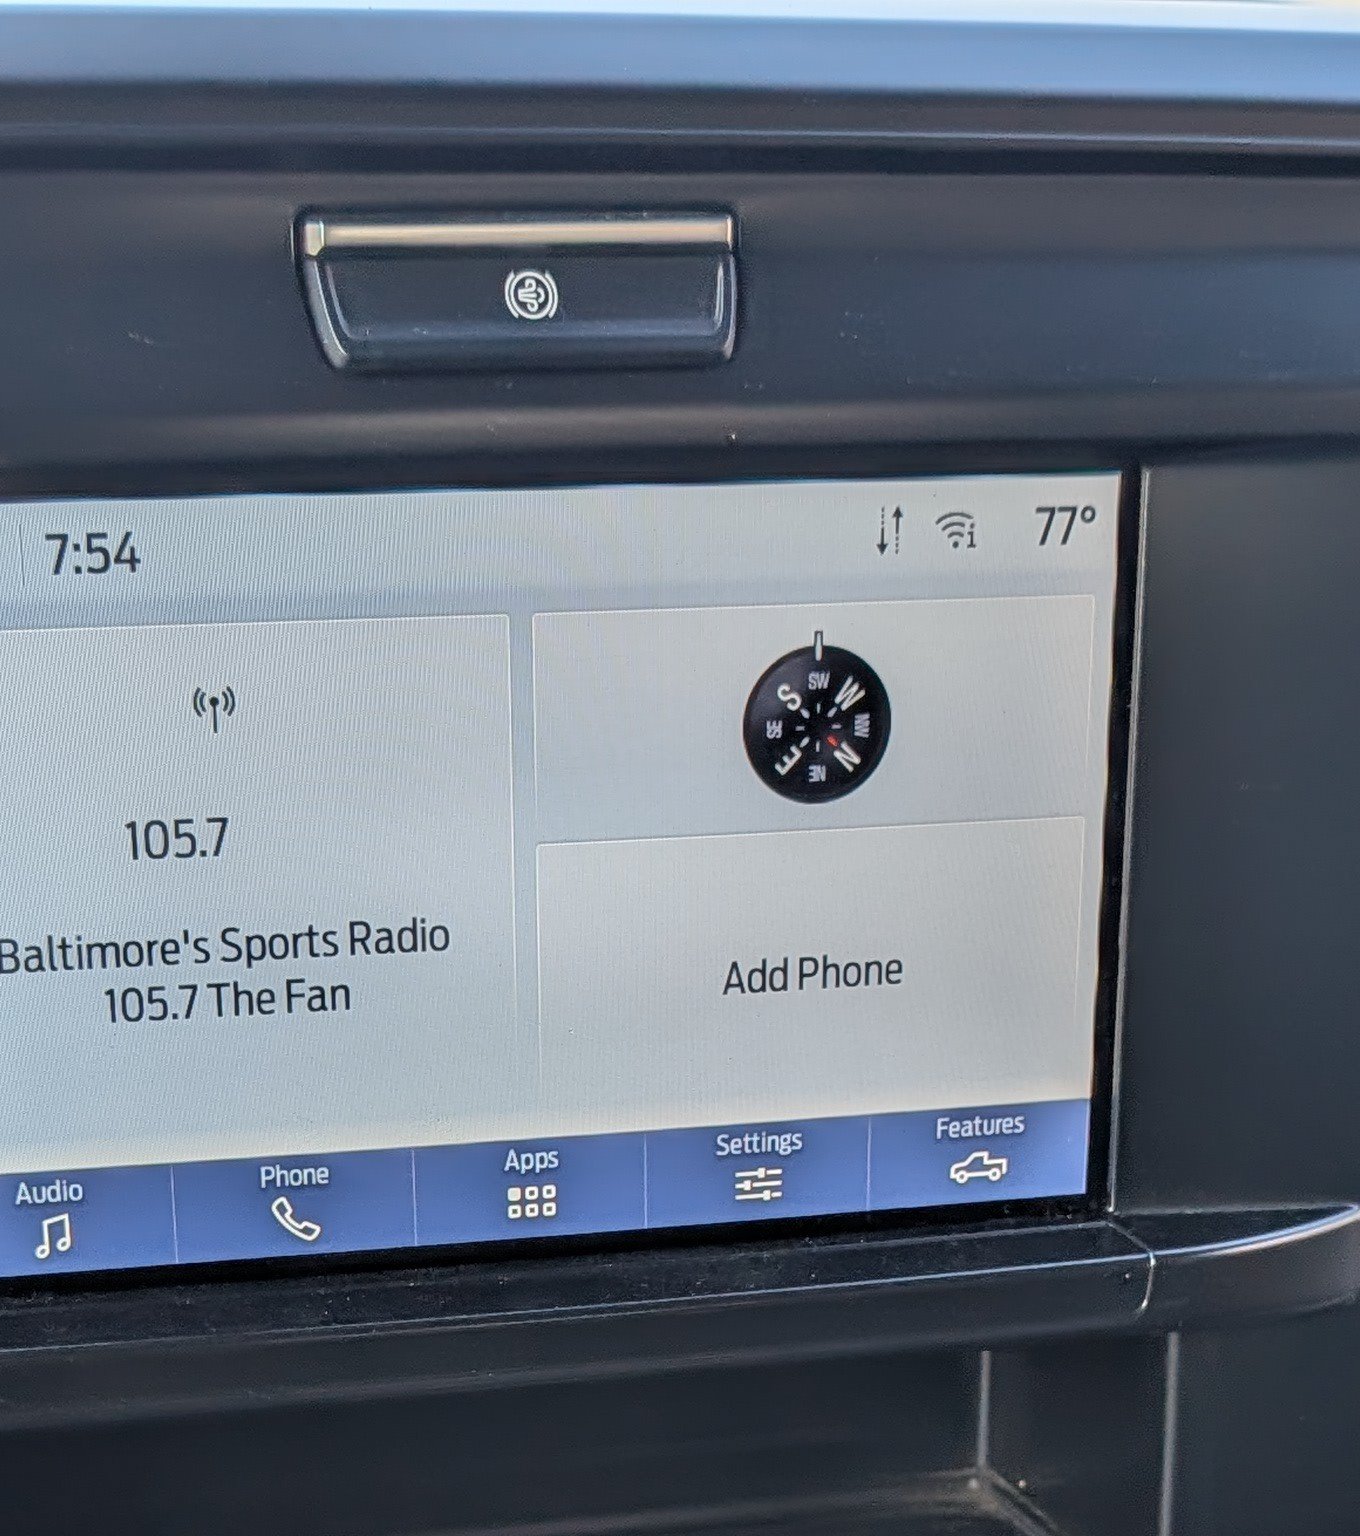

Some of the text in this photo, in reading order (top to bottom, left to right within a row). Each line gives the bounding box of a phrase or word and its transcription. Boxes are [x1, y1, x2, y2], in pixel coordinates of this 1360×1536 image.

[44, 531, 142, 576] 7:54
[808, 670, 831, 690] SW
[124, 818, 230, 861] 105.7
[220, 923, 340, 968] Sports
[348, 918, 451, 957] Radio
[722, 954, 903, 995] Add Phone
[104, 977, 352, 1023] 105.7 The Fan
[936, 1115, 1026, 1140] Features
[715, 1131, 803, 1157] Settings
[503, 1148, 560, 1173] Apps
[260, 1164, 330, 1189] Phone
[14, 1179, 84, 1206] Audio
